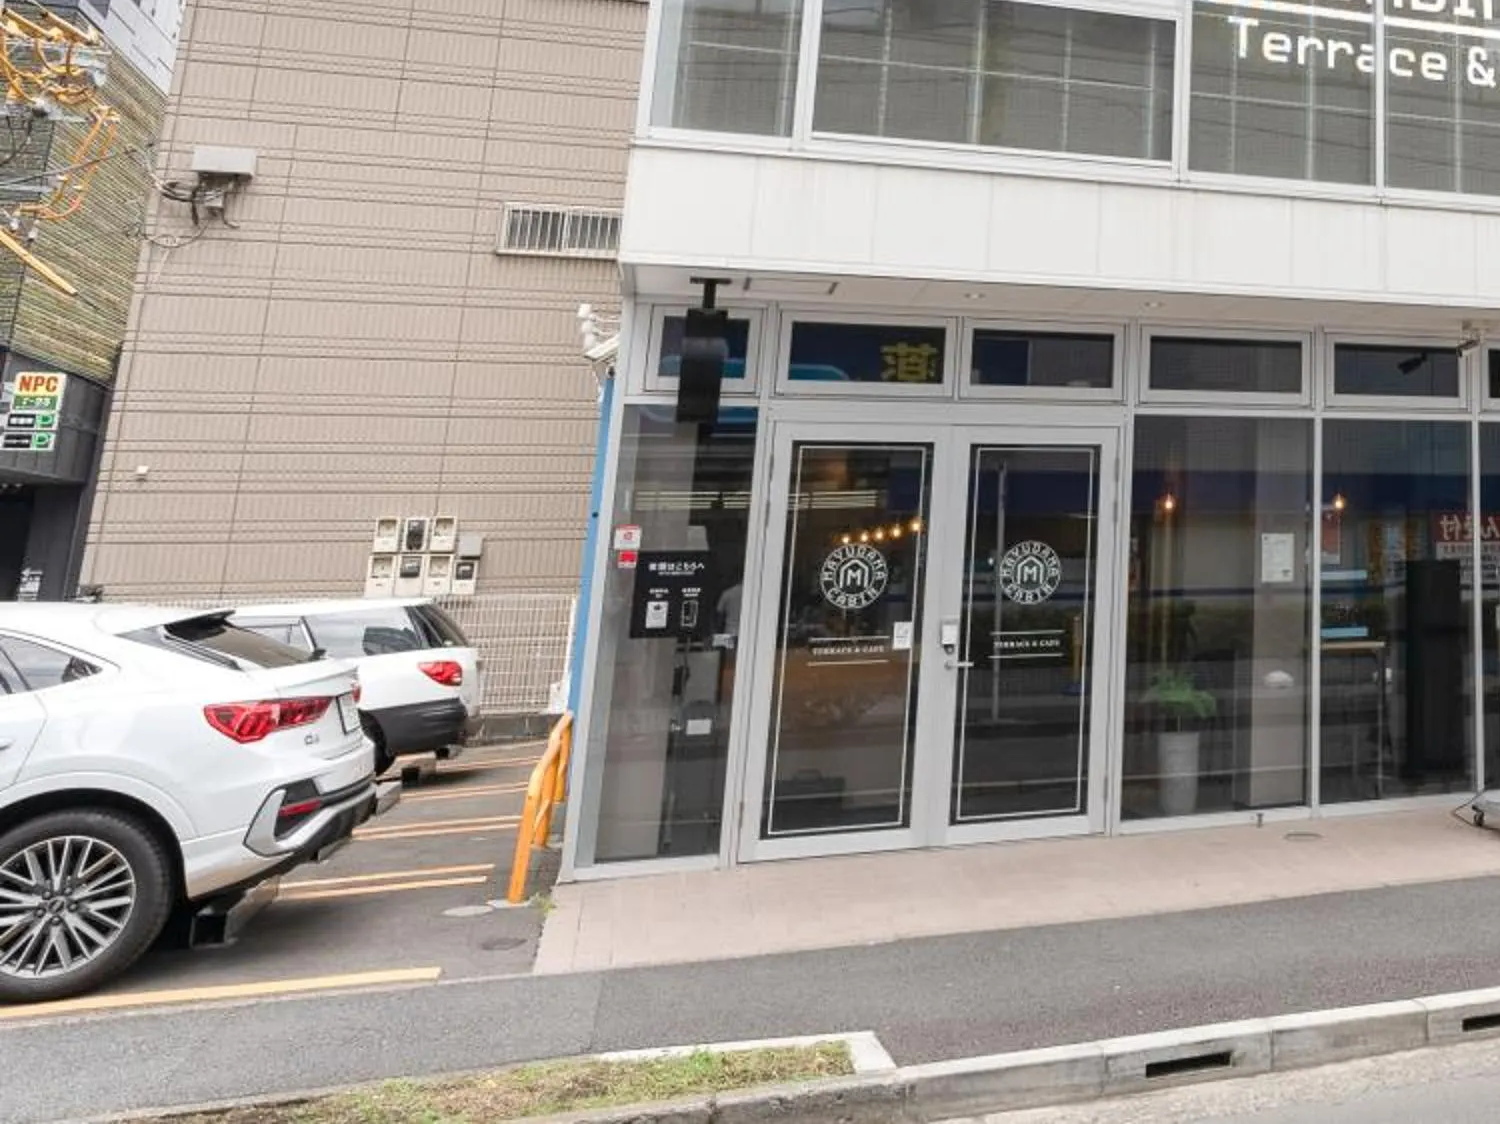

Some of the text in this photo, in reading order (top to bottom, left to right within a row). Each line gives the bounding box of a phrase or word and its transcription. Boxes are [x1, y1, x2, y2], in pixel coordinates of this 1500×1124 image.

[1228, 15, 1447, 81] Terrace
[1466, 51, 1497, 88] &
[19, 375, 58, 392] NPC
